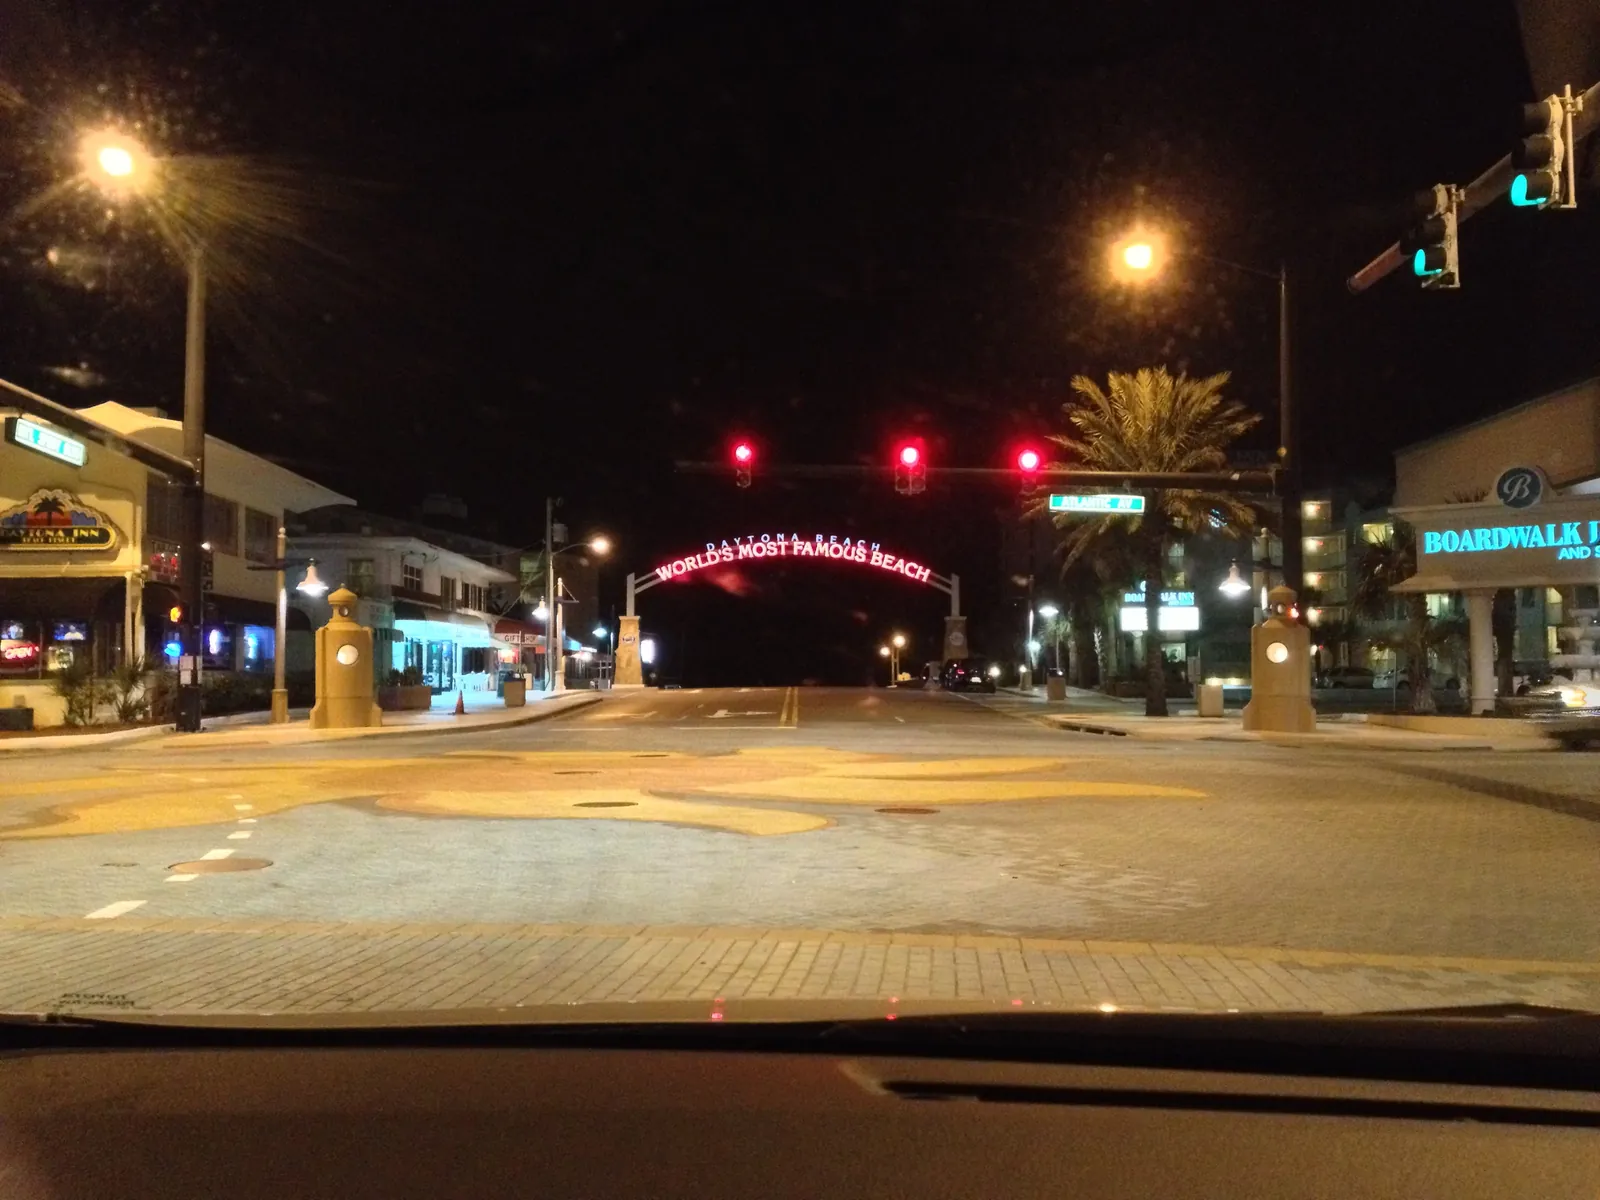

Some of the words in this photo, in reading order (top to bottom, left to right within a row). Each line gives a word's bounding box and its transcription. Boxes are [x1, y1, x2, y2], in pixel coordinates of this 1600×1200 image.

[1060, 495, 1112, 509] ATLANTIC
[1116, 497, 1133, 509] AV
[72, 528, 99, 538] INN
[1424, 522, 1583, 554] BOARDWALK
[706, 532, 799, 552] DAYTONA
[815, 533, 880, 552] BEACH
[1558, 545, 1591, 561] AND
[655, 547, 734, 581] WORLD'S
[738, 541, 788, 559] MOST
[793, 541, 868, 562] FAMOUS
[870, 551, 931, 582] BEACH
[504, 634, 520, 642] GIFT
[5, 646, 33, 660] OPEN
